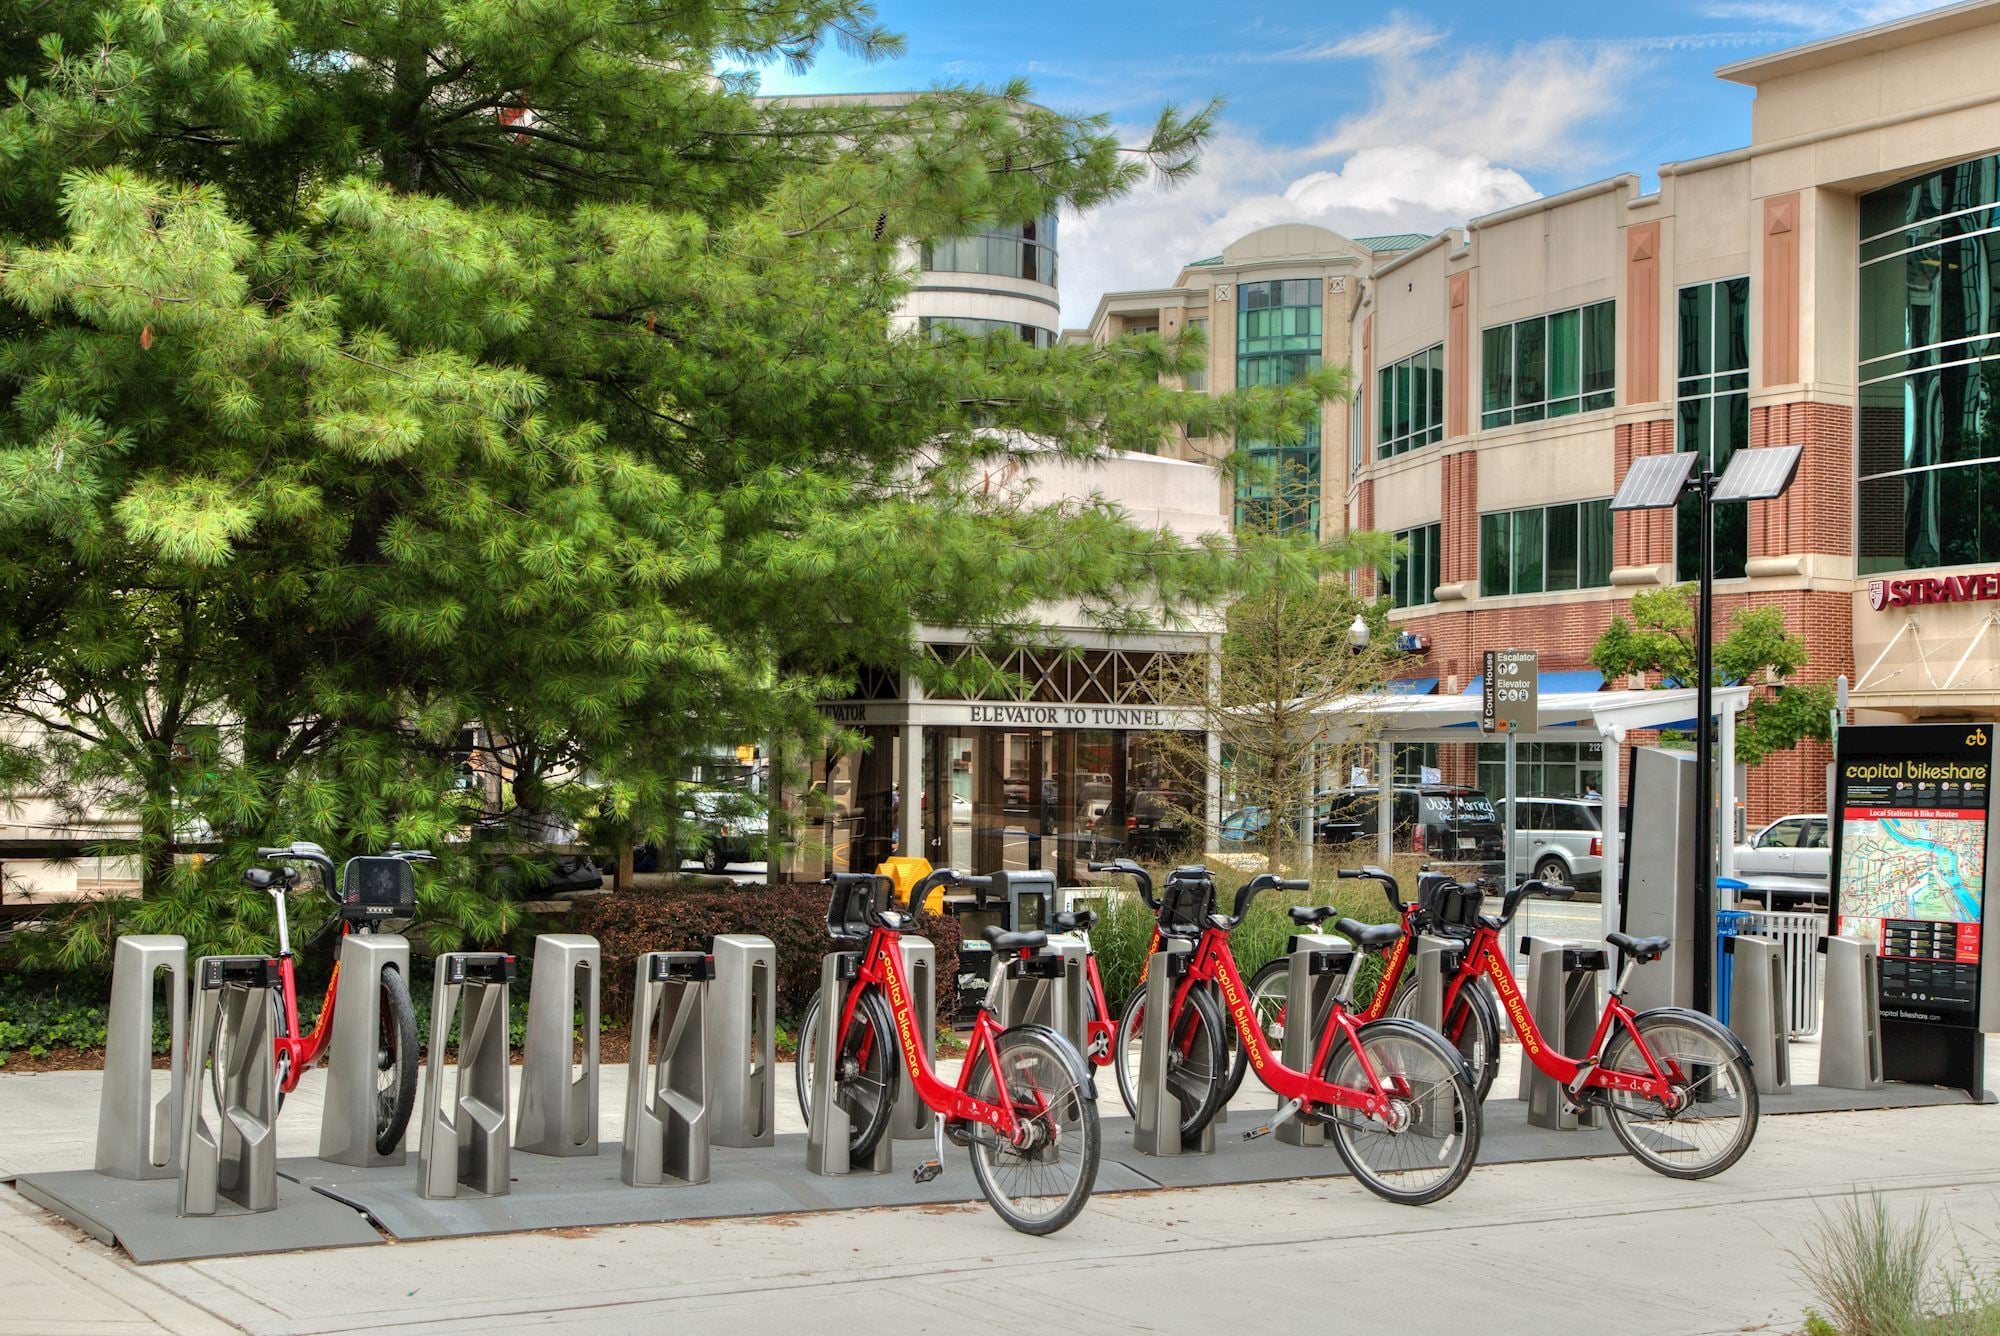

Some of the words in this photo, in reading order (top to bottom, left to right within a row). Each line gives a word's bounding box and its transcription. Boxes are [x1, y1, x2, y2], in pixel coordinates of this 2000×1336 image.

[1888, 573, 2000, 608] STRAYE
[1485, 653, 1493, 686] House
[1497, 653, 1535, 662] Escalator
[1497, 680, 1531, 688] Elevator
[818, 704, 866, 721] EVATOR
[1485, 687, 1493, 717] Court
[971, 706, 1058, 723] ELEVATOR
[1064, 708, 1086, 724] TO
[1090, 709, 1164, 726] TUNNEL
[1846, 762, 1903, 782] capital
[1906, 760, 1987, 780] bikeshare
[1426, 797, 1453, 811] Just
[1456, 796, 1494, 813] Married
[1869, 809, 1886, 817] Local
[1887, 809, 1912, 817] Stations
[1371, 982, 1387, 1018] capital
[1383, 936, 1406, 981] bikeshare
[884, 957, 905, 1006] capital
[898, 1007, 920, 1077] bikeshare
[1487, 955, 1514, 996] capital
[1509, 996, 1539, 1055] bikeshare
[1235, 1006, 1264, 1070] bikeshare
